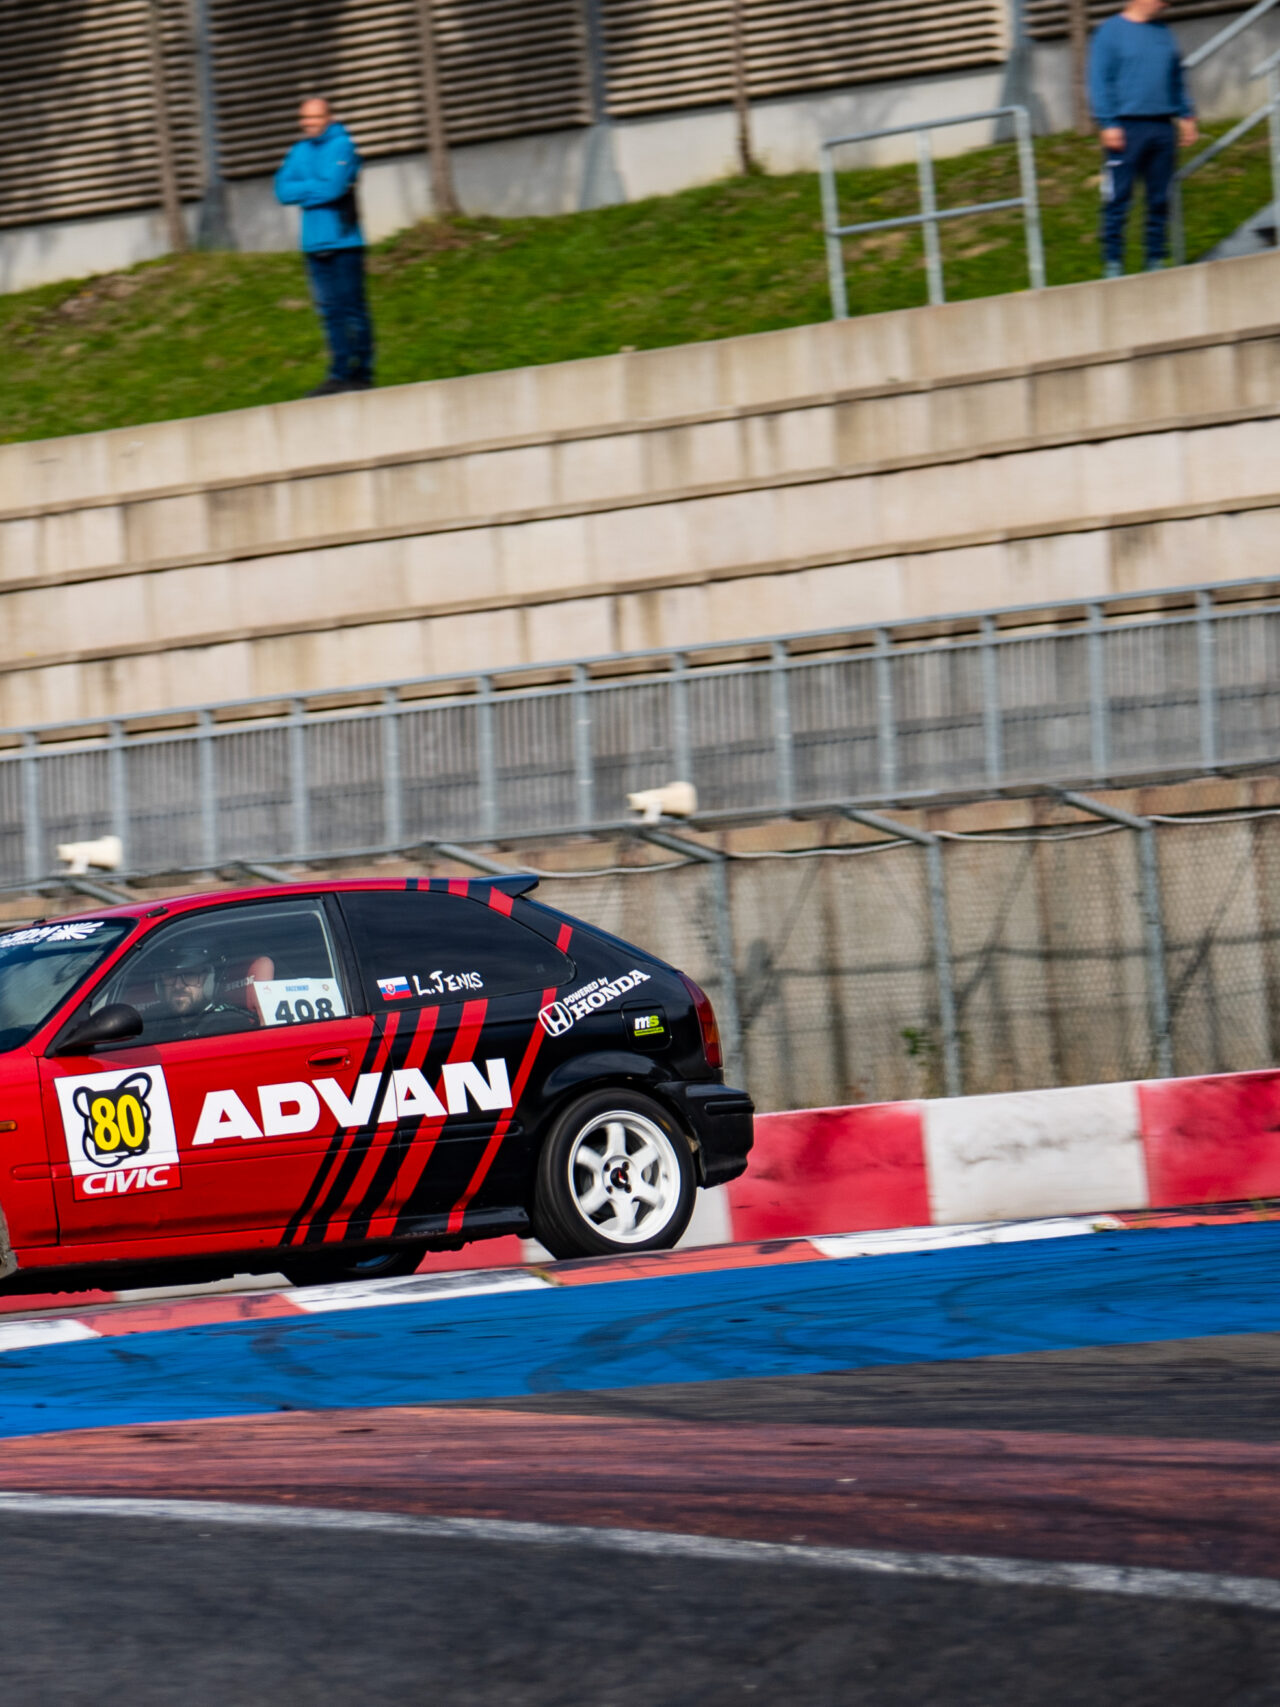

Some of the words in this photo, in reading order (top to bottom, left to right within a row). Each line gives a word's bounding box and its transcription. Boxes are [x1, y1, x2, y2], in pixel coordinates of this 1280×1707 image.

[275, 998, 335, 1024] 408
[563, 981, 599, 1006] POWERED
[569, 969, 651, 1020] HONDA
[192, 1058, 512, 1146] ADVAN
[91, 1094, 145, 1151] 80
[82, 1165, 170, 1195] CIVIC
